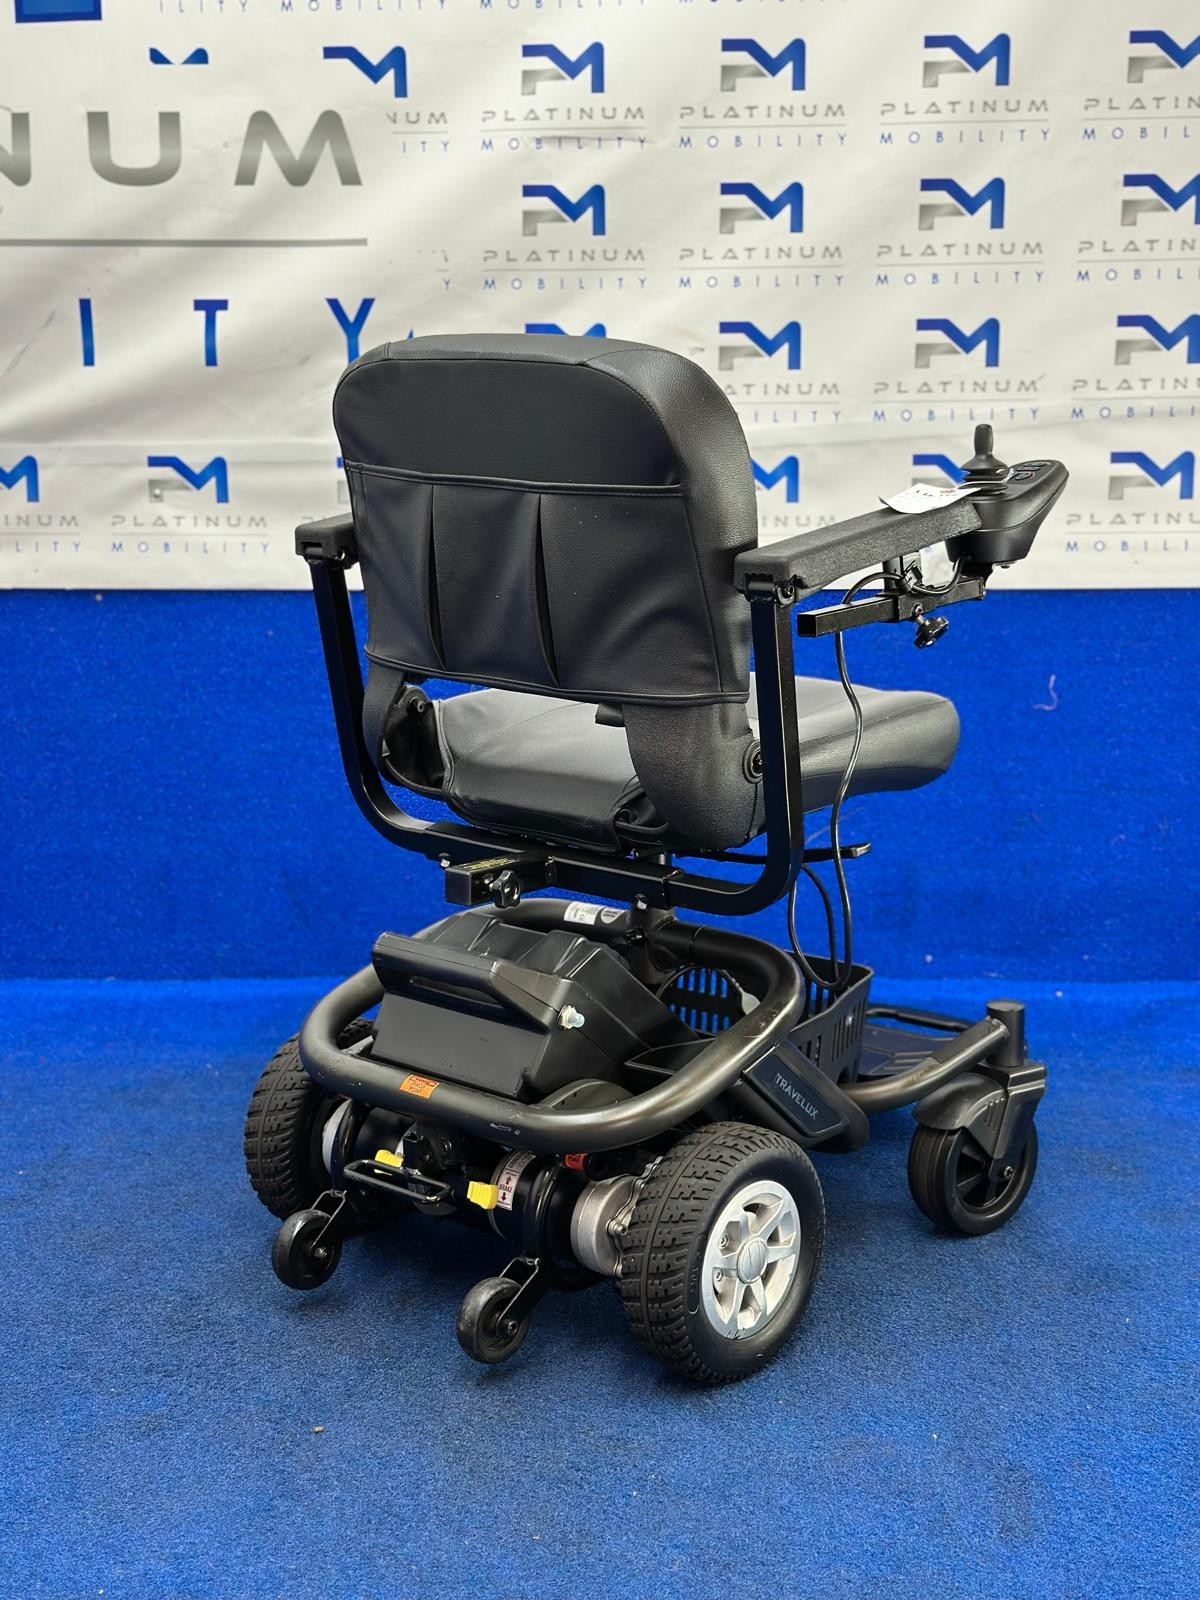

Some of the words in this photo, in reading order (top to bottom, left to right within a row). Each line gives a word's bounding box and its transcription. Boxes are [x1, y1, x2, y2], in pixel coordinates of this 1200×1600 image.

[481, 106, 644, 122] PLATINUM
[680, 103, 845, 119] PLATINUM
[881, 99, 1049, 115] PLATINUM
[679, 133, 846, 148] MOBILITY
[880, 128, 1049, 144] MOBILITY
[402, 140, 450, 152] ITY
[481, 136, 646, 152] MOBILITY
[680, 245, 843, 261] PLATINUM
[876, 240, 1043, 258] PLATINUM
[1078, 239, 1200, 254] PLATIN
[483, 248, 644, 262] PLATINUM
[484, 276, 646, 290] MOBILITY
[679, 274, 844, 288] MOBILITY
[876, 269, 1044, 286] MOBILITY
[874, 379, 1038, 394] PLATINUM
[873, 406, 1039, 422] MOBILITY
[112, 515, 267, 527] PLATINUM
[112, 541, 269, 554] MOBILITY
[1066, 540, 1189, 552] MOBILI
[774, 1072, 819, 1119] TRAVELUX
